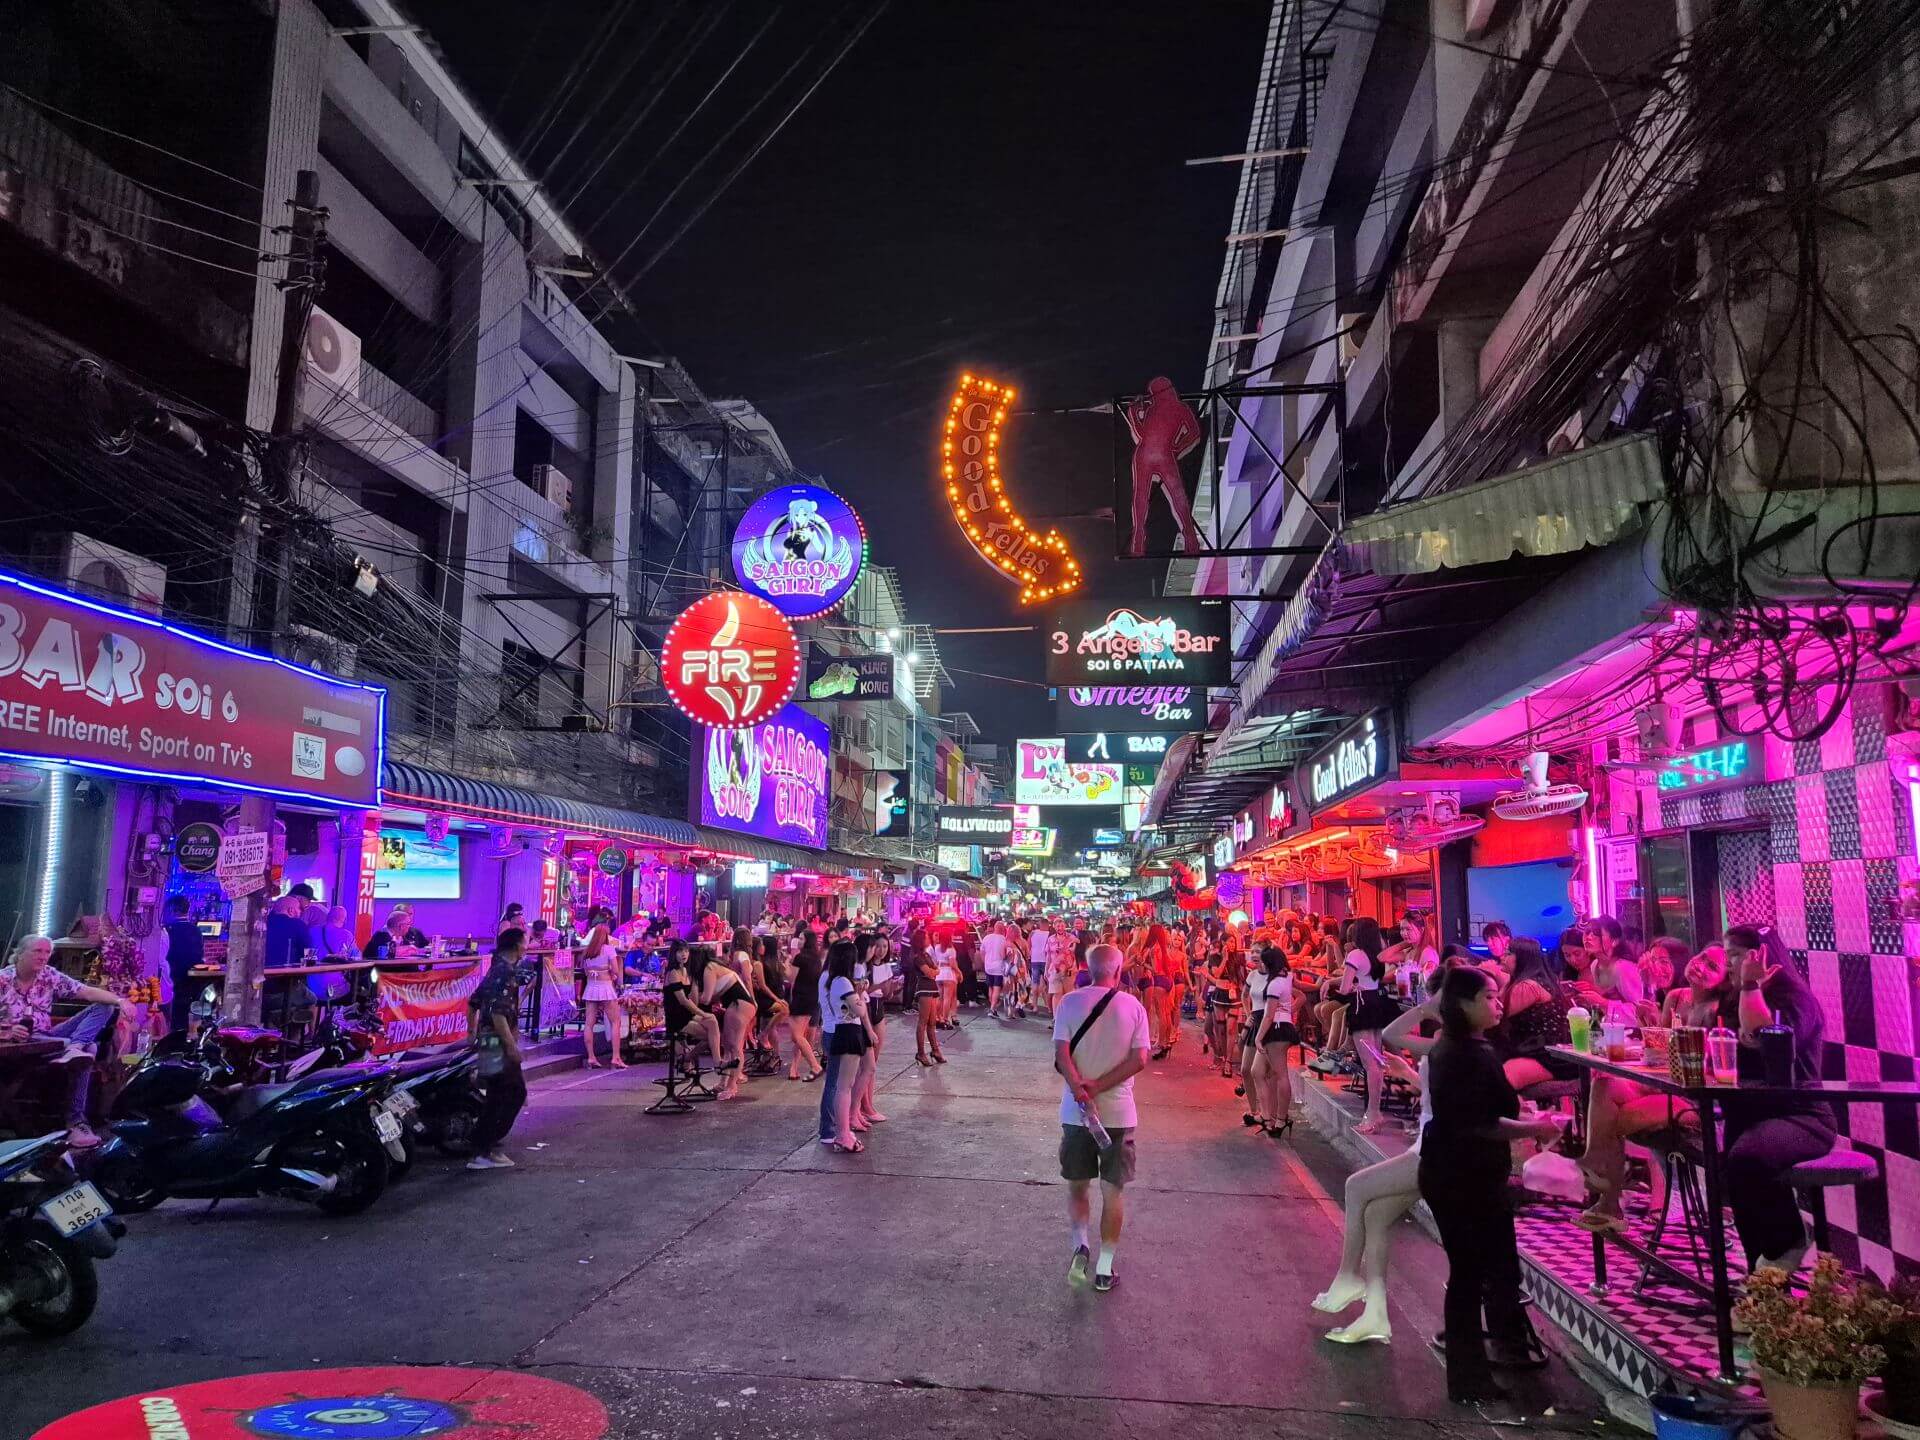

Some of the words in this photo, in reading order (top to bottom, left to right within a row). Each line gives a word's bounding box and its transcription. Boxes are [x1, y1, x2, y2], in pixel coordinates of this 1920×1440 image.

[962, 402, 991, 513] Good
[751, 560, 841, 580] SAIGON
[767, 577, 827, 597] GIRL
[1052, 631, 1069, 655] 3
[1077, 631, 1165, 661] Angels
[1172, 629, 1221, 654] Bar
[682, 650, 777, 685] FIRE
[861, 661, 888, 675] KING
[1087, 659, 1110, 671] SOI
[1113, 659, 1122, 671] 6
[1125, 658, 1185, 671] PATTAYA
[860, 680, 889, 695] KONG
[222, 690, 239, 723] 6
[1154, 702, 1193, 721] Bar
[47, 708, 132, 751] Internet,
[139, 727, 190, 758] Sport
[194, 743, 215, 762] on
[220, 742, 252, 769] Tv's
[1128, 736, 1167, 753] BAR
[762, 724, 827, 795] SAIGON
[775, 778, 816, 837] GIRL
[941, 816, 1012, 833] HOLLYWOOD
[181, 845, 216, 858] Chang
[358, 853, 377, 914] FIRE
[68, 1207, 104, 1231] 3652
